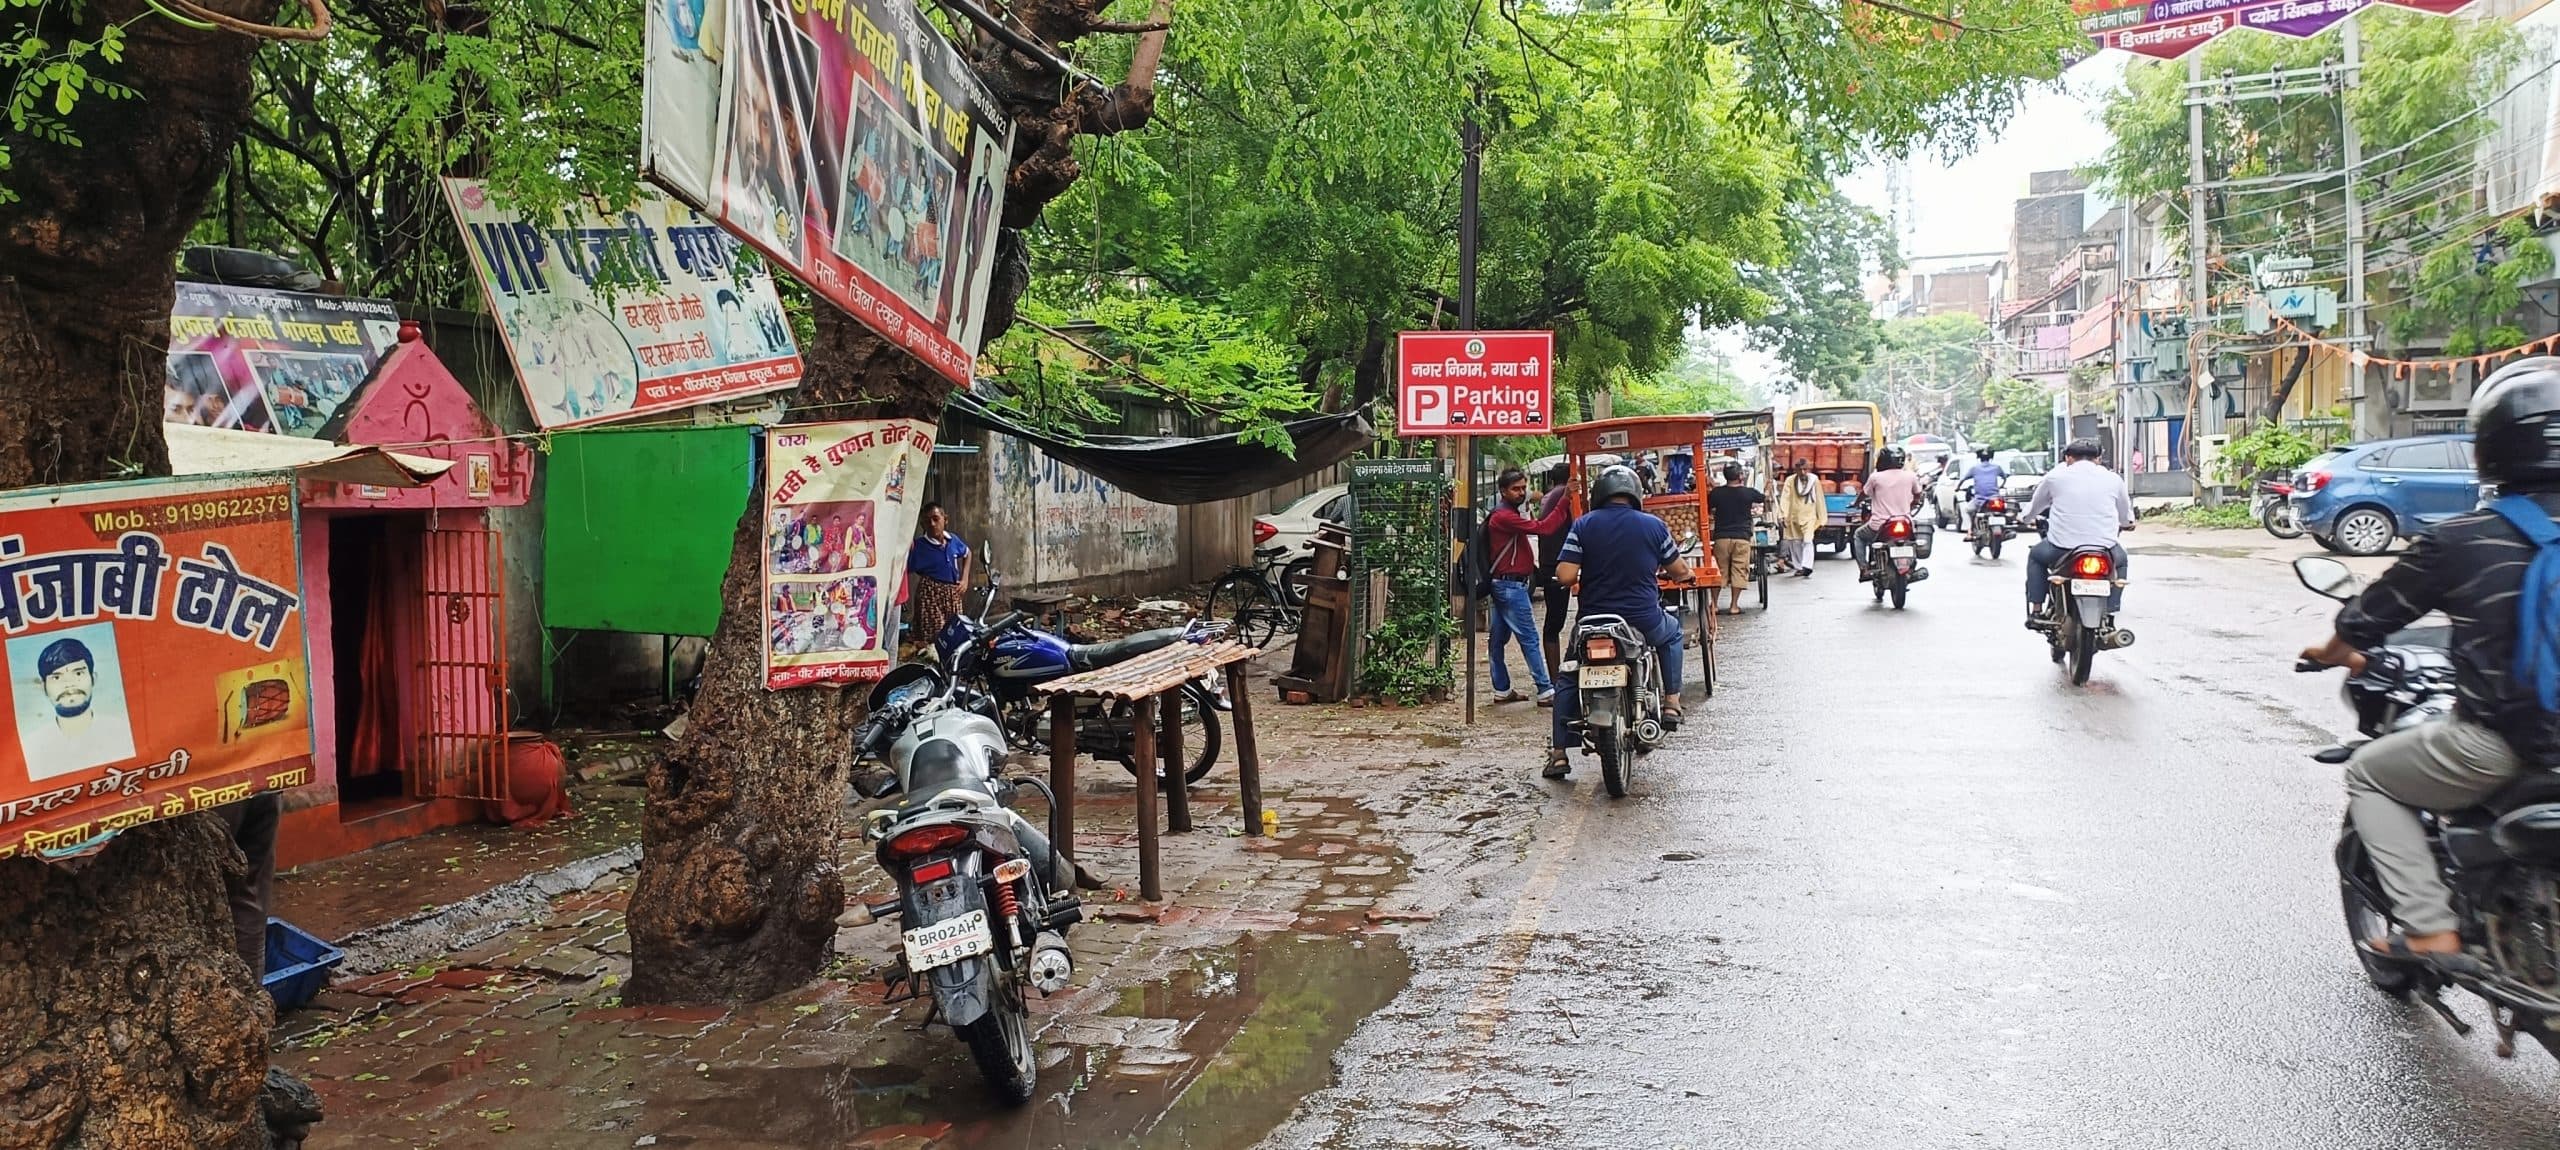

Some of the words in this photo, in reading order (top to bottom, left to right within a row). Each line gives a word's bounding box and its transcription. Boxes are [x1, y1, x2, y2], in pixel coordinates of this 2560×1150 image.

[2154, 2, 2169, 20] (2)
[2189, 15, 2225, 36] साड़ी
[2247, 7, 2281, 24] प्योर
[2282, 2, 2325, 20] सिल्क
[851, 3, 899, 86] पंजाबी
[943, 102, 970, 157] पार्टी
[469, 222, 551, 296] VIP
[623, 303, 641, 329] हर
[640, 295, 667, 333] खुशी
[665, 297, 681, 324] के
[679, 292, 705, 322] मौके
[814, 257, 846, 289] पता:-
[849, 275, 876, 313] जिला
[940, 344, 954, 365] के
[220, 311, 279, 340] पंजाबी
[279, 311, 328, 348] भांगड़ा
[326, 319, 363, 346] पार्टी
[637, 345, 658, 368] पर
[656, 338, 691, 366] सम्पर्क
[1411, 362, 1443, 378] नगर
[1445, 356, 1488, 379] निगम,
[1490, 362, 1518, 378] गया
[1520, 356, 1541, 378] जी
[645, 384, 668, 400] पता
[1453, 385, 1540, 410] Parking
[1469, 406, 1522, 425] Area
[772, 468, 808, 504] यही
[801, 454, 823, 475] है
[823, 430, 876, 467] तुफान
[880, 422, 912, 445] ढोल
[165, 494, 291, 526] 9199622379
[173, 541, 299, 653] ढोल
[798, 667, 814, 679] पीर
[839, 663, 860, 678] जिला
[0, 784, 83, 826] ास्टर
[147, 748, 191, 781] जी
[24, 822, 91, 855] जिला
[161, 793, 186, 817] के
[189, 780, 253, 810] निकट
[265, 767, 308, 791] गया
[918, 919, 977, 947] BR02AH
[925, 941, 978, 965] 4489
